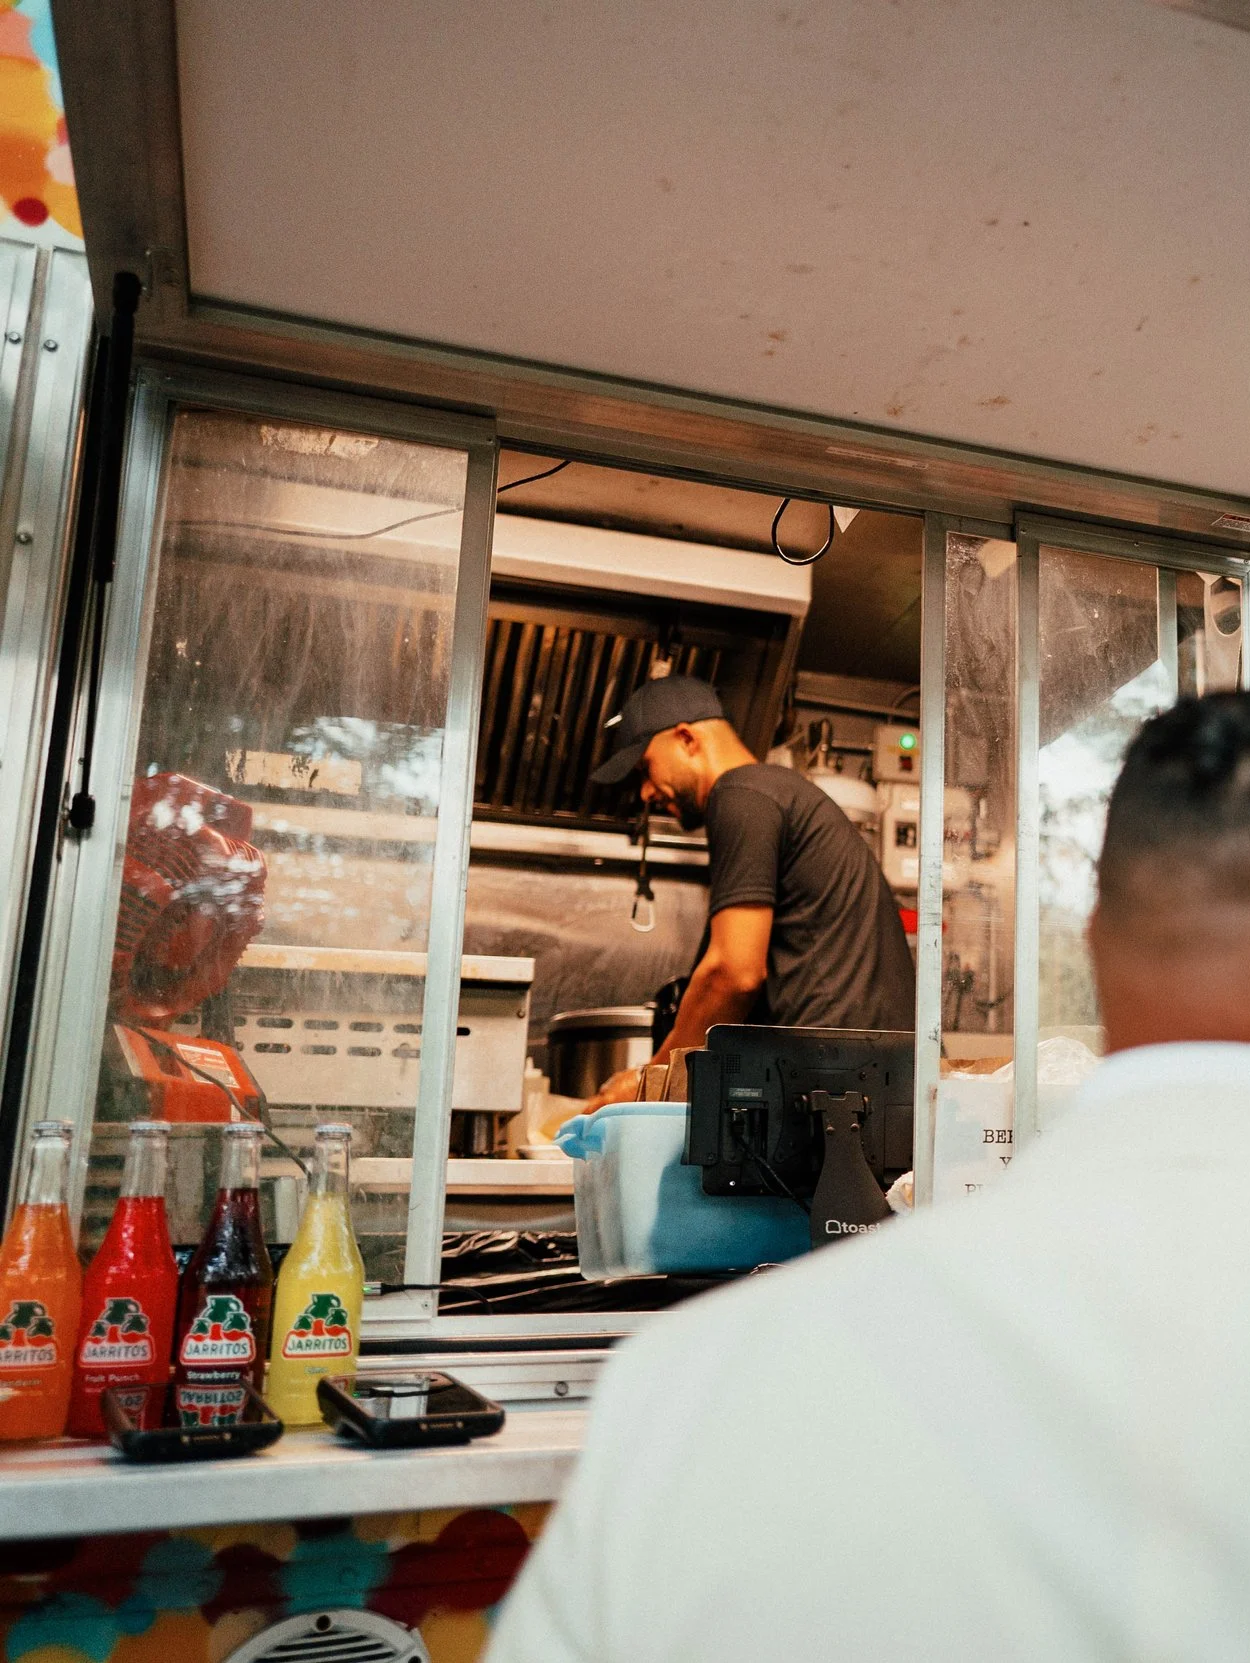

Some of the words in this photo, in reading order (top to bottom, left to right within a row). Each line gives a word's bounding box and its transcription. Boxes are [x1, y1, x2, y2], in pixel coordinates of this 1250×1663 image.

[841, 1221, 882, 1235] toast
[186, 1342, 248, 1355] JARRITOS
[287, 1337, 348, 1352] JARRITOS
[85, 1345, 148, 1360] JARRITOS
[187, 1371, 241, 1380] Strawberry
